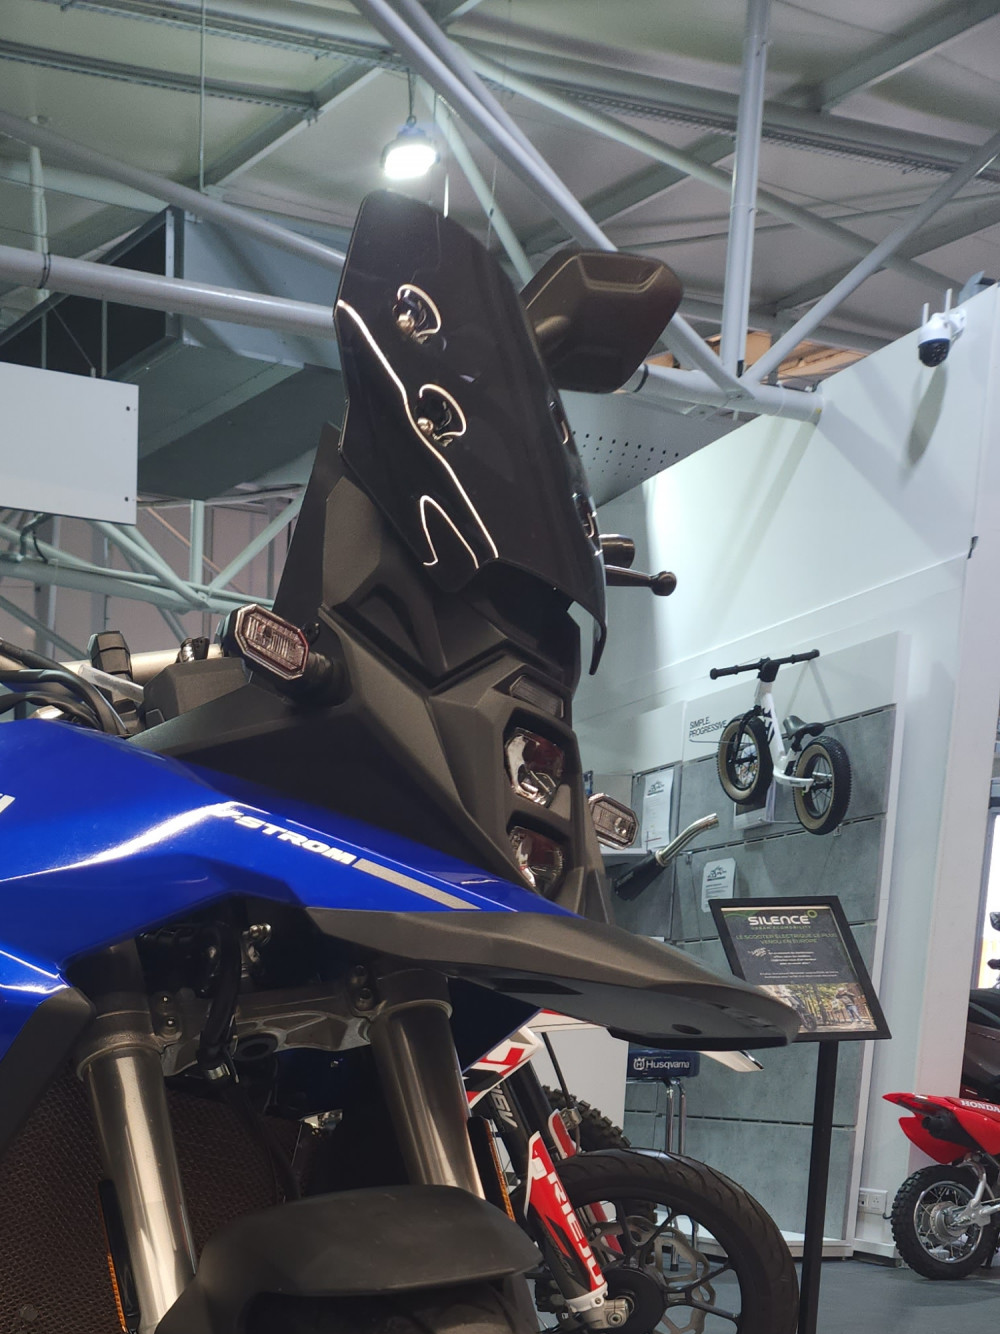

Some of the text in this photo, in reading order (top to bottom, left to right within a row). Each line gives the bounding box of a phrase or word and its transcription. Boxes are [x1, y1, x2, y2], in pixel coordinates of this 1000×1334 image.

[690, 717, 710, 729] SIMPLE
[748, 915, 811, 926] SILENCE
[646, 1060, 690, 1070] Husqvarna
[547, 1170, 607, 1287] RIEJU
